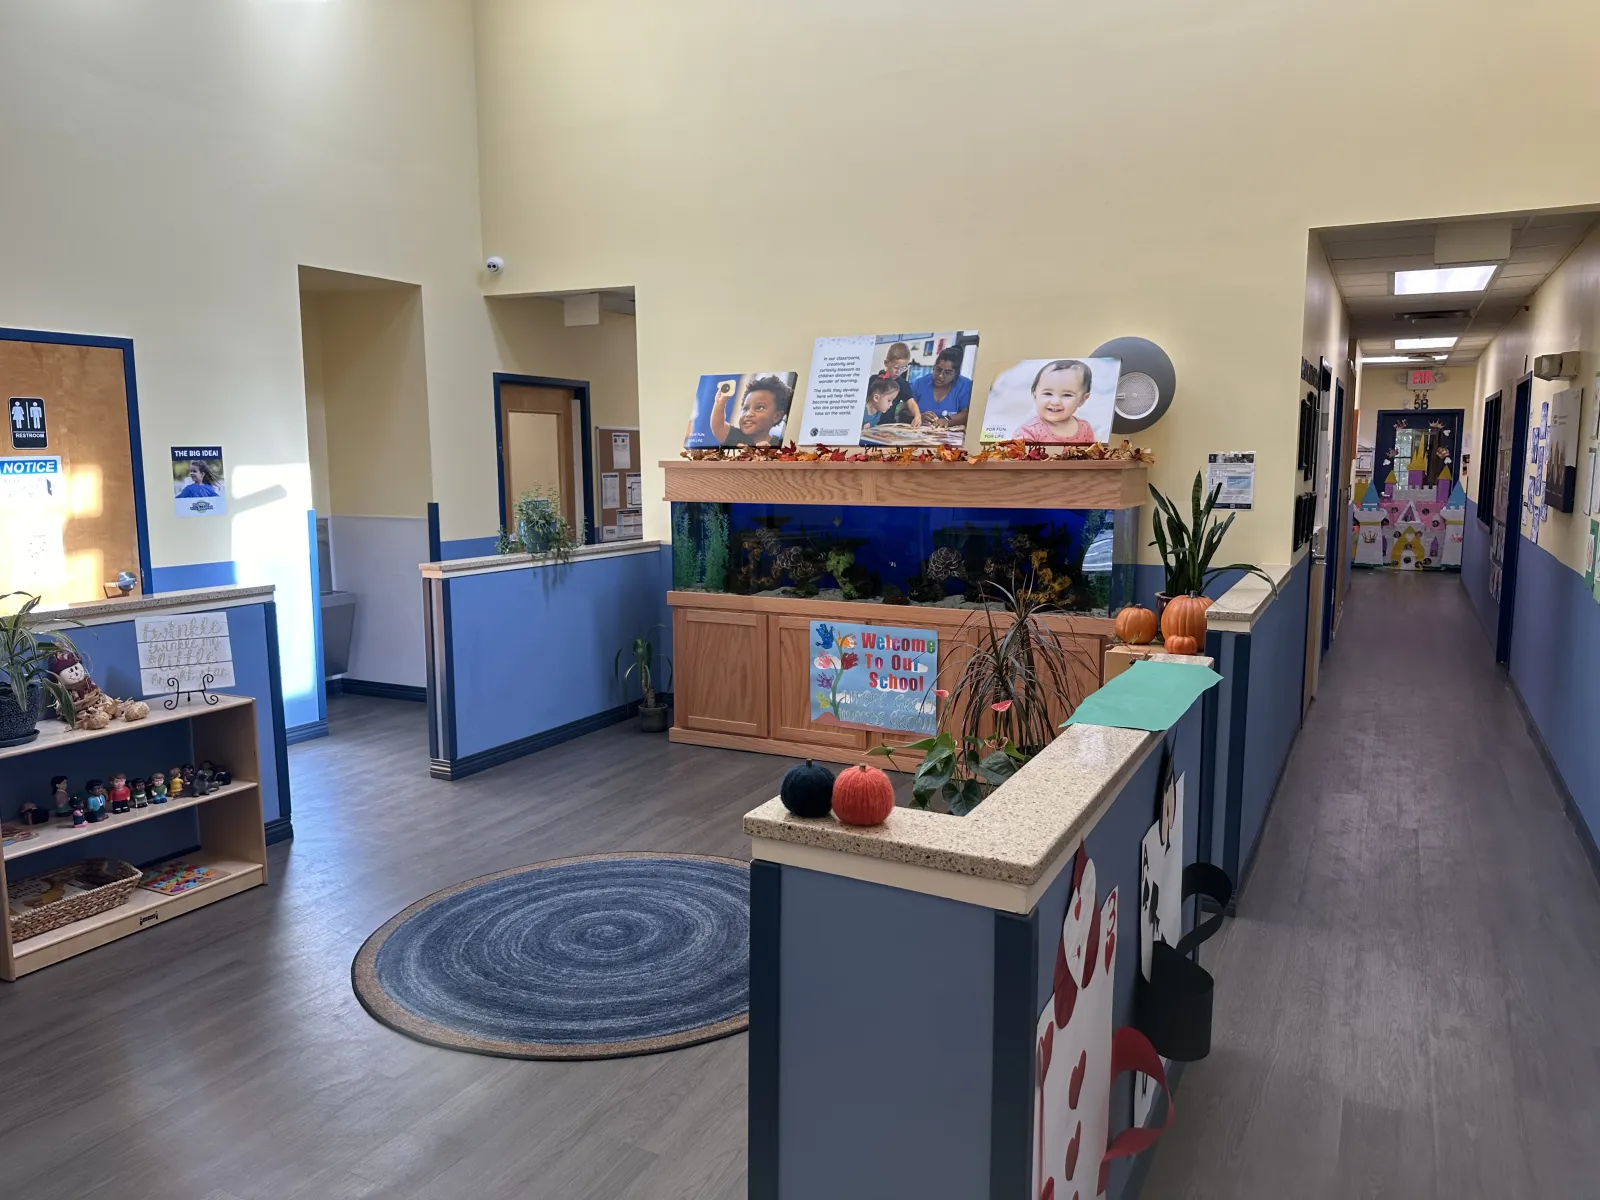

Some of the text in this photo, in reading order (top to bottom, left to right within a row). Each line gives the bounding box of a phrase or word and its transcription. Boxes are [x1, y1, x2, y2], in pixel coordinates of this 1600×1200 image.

[1412, 370, 1432, 384] EXIT
[1414, 399, 1428, 409] 5B
[3, 461, 55, 474] NOTICE
[142, 618, 222, 641] twinkle
[202, 637, 220, 652] my
[861, 632, 936, 654] Welcome
[158, 648, 218, 672] little
[865, 653, 920, 672] To Our
[869, 672, 924, 691] School
[1142, 844, 1149, 882] A
[1106, 891, 1116, 937] 3
